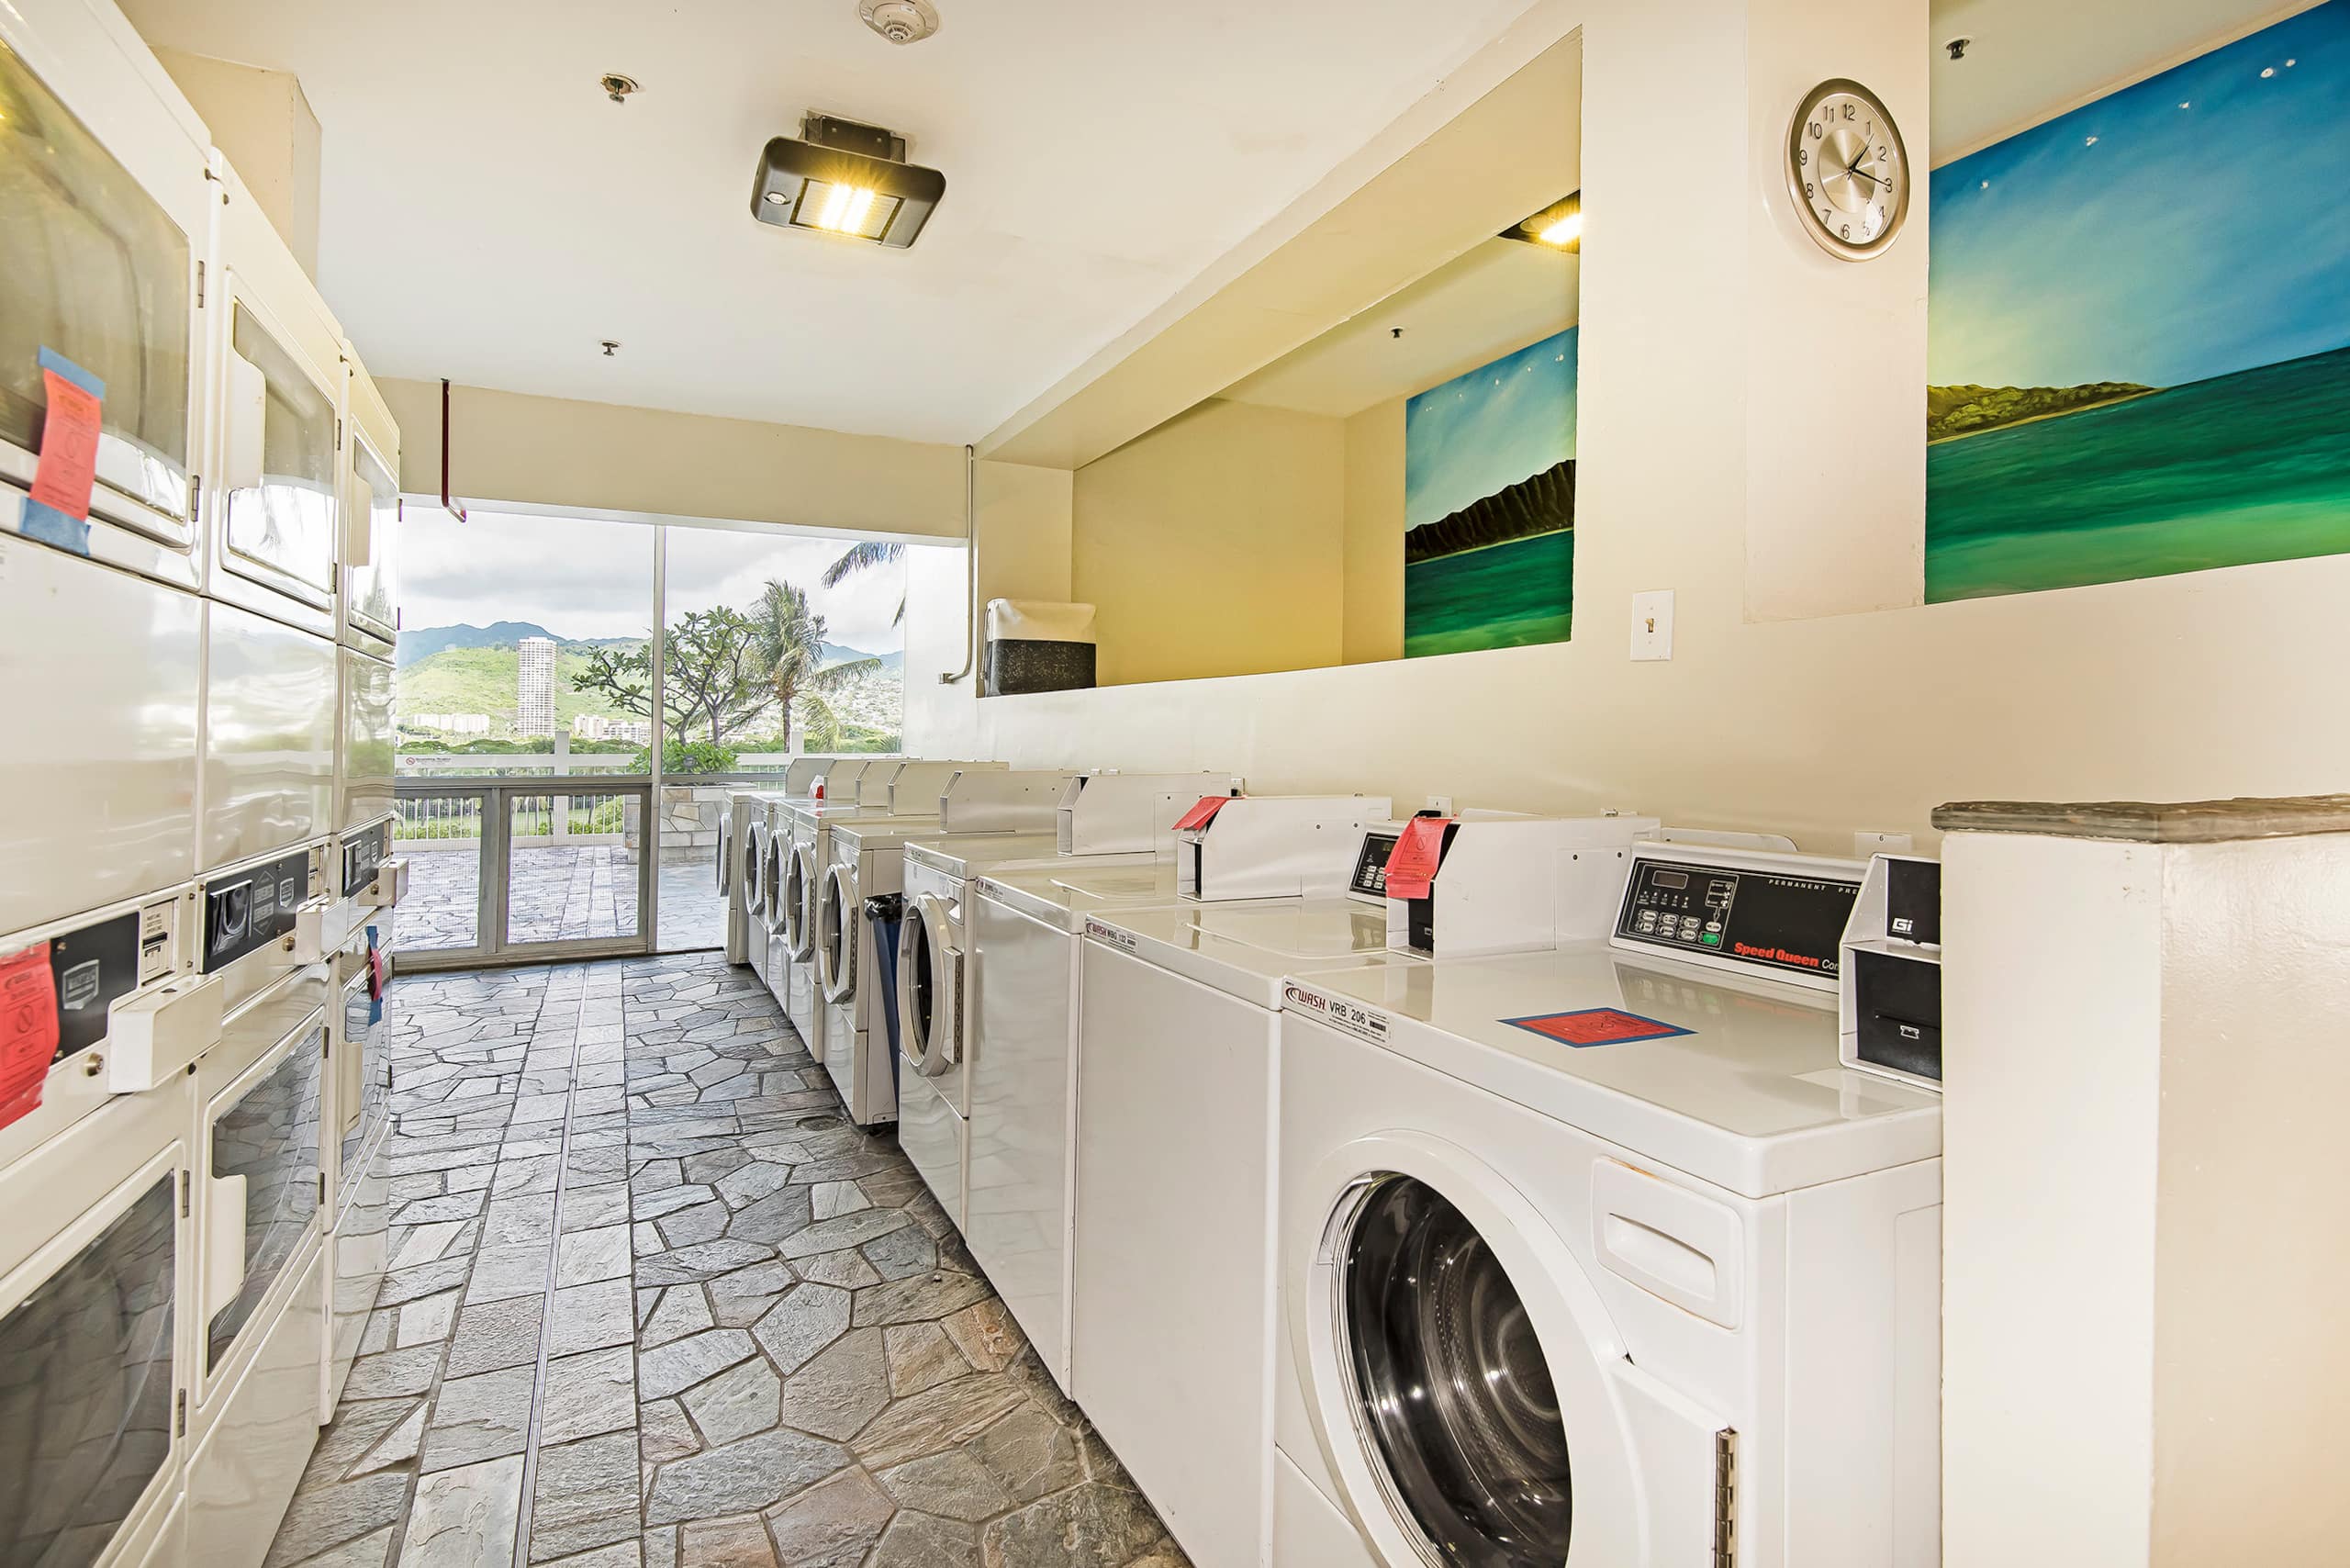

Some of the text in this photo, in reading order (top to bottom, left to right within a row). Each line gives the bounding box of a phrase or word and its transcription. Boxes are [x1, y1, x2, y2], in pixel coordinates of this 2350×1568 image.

[1823, 106, 1835, 123] 11
[1842, 103, 1855, 121] 12
[1808, 121, 1822, 140] 10
[1865, 121, 1872, 136] 1
[1799, 150, 1807, 165] 9
[1878, 146, 1887, 162] 2
[1806, 183, 1814, 199] 8
[1885, 178, 1893, 193] 3
[1823, 208, 1832, 225] 7
[1878, 206, 1885, 218] 4
[1841, 223, 1851, 240] 6
[1768, 879, 1827, 891] PERMANENT
[1734, 941, 1775, 959] Speed
[1775, 948, 1819, 968] Queen
[1298, 990, 1326, 1011] WASH
[1329, 1000, 1347, 1017] VRB
[1351, 1009, 1366, 1025] 206
